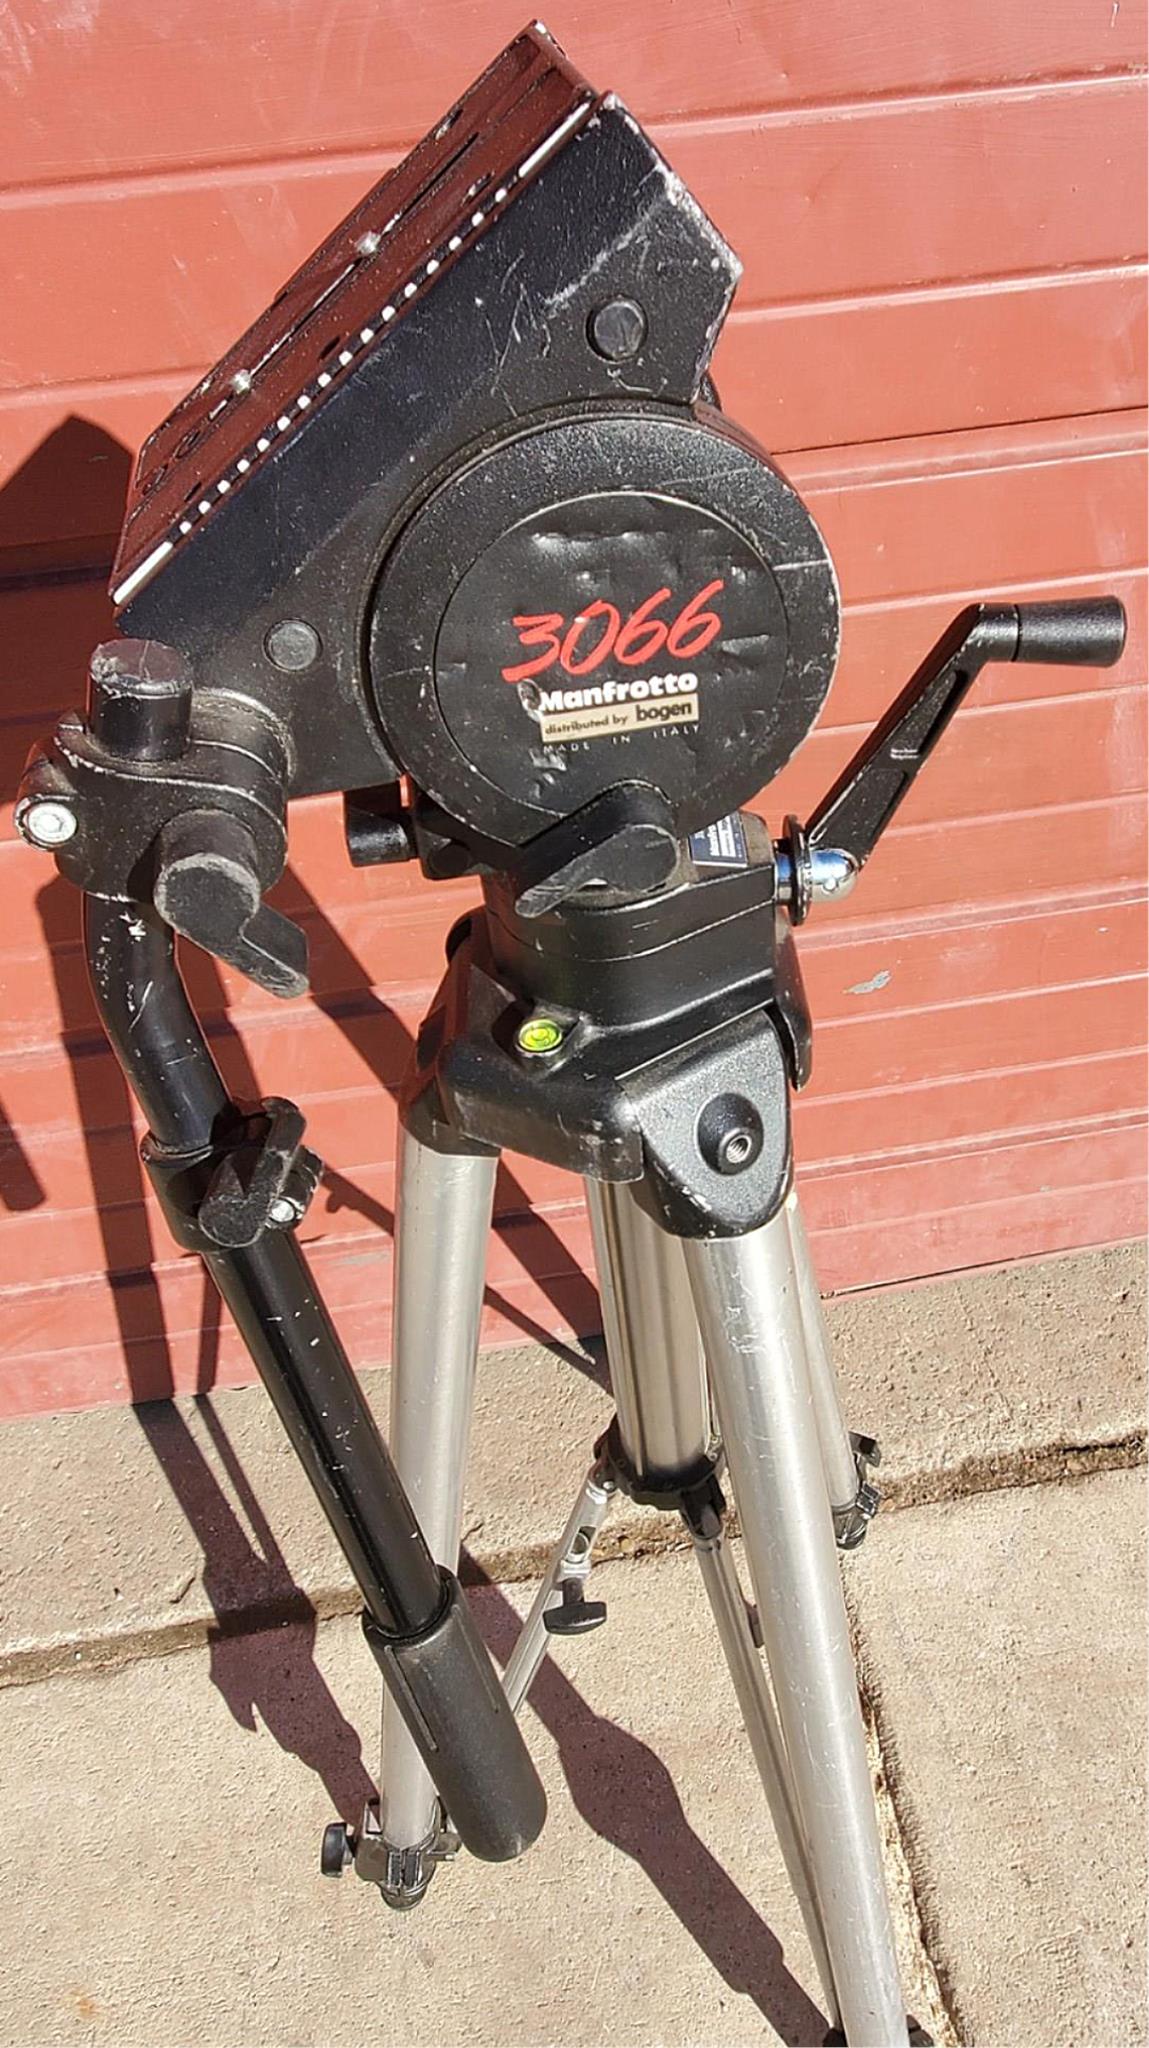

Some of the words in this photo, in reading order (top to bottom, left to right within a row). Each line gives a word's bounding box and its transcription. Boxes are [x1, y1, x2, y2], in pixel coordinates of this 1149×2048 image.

[501, 579, 724, 682] 3066
[538, 672, 698, 712] Manfrotto
[544, 714, 609, 735] distributed
[612, 713, 628, 725] by
[636, 701, 692, 722] bogen
[543, 742, 590, 755] MADE
[612, 735, 631, 745] IN
[653, 724, 700, 739] ITALY
